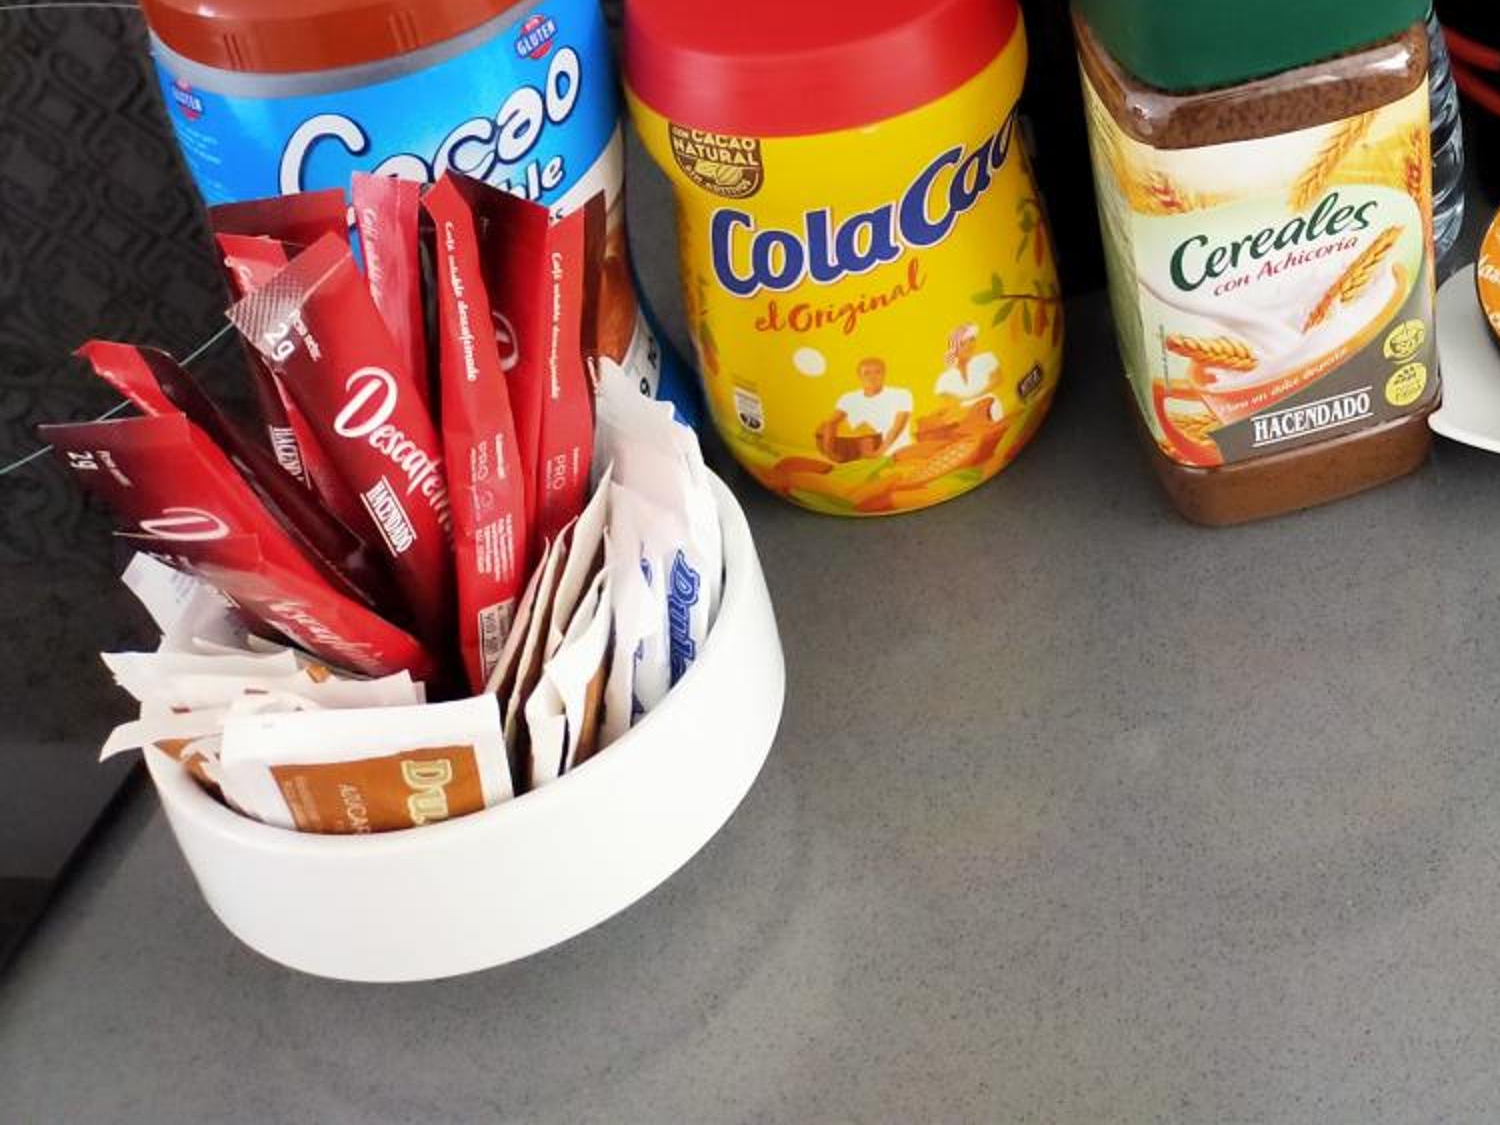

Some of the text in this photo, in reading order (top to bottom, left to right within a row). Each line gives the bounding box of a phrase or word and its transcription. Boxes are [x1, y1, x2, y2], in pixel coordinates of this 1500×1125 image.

[673, 136, 760, 166] NATURAL
[691, 129, 757, 152] CACAO
[1169, 192, 1380, 293] Cereales
[1213, 234, 1360, 297] con Achicoria
[754, 259, 927, 334] el Original
[1253, 393, 1371, 442] HACENDADO
